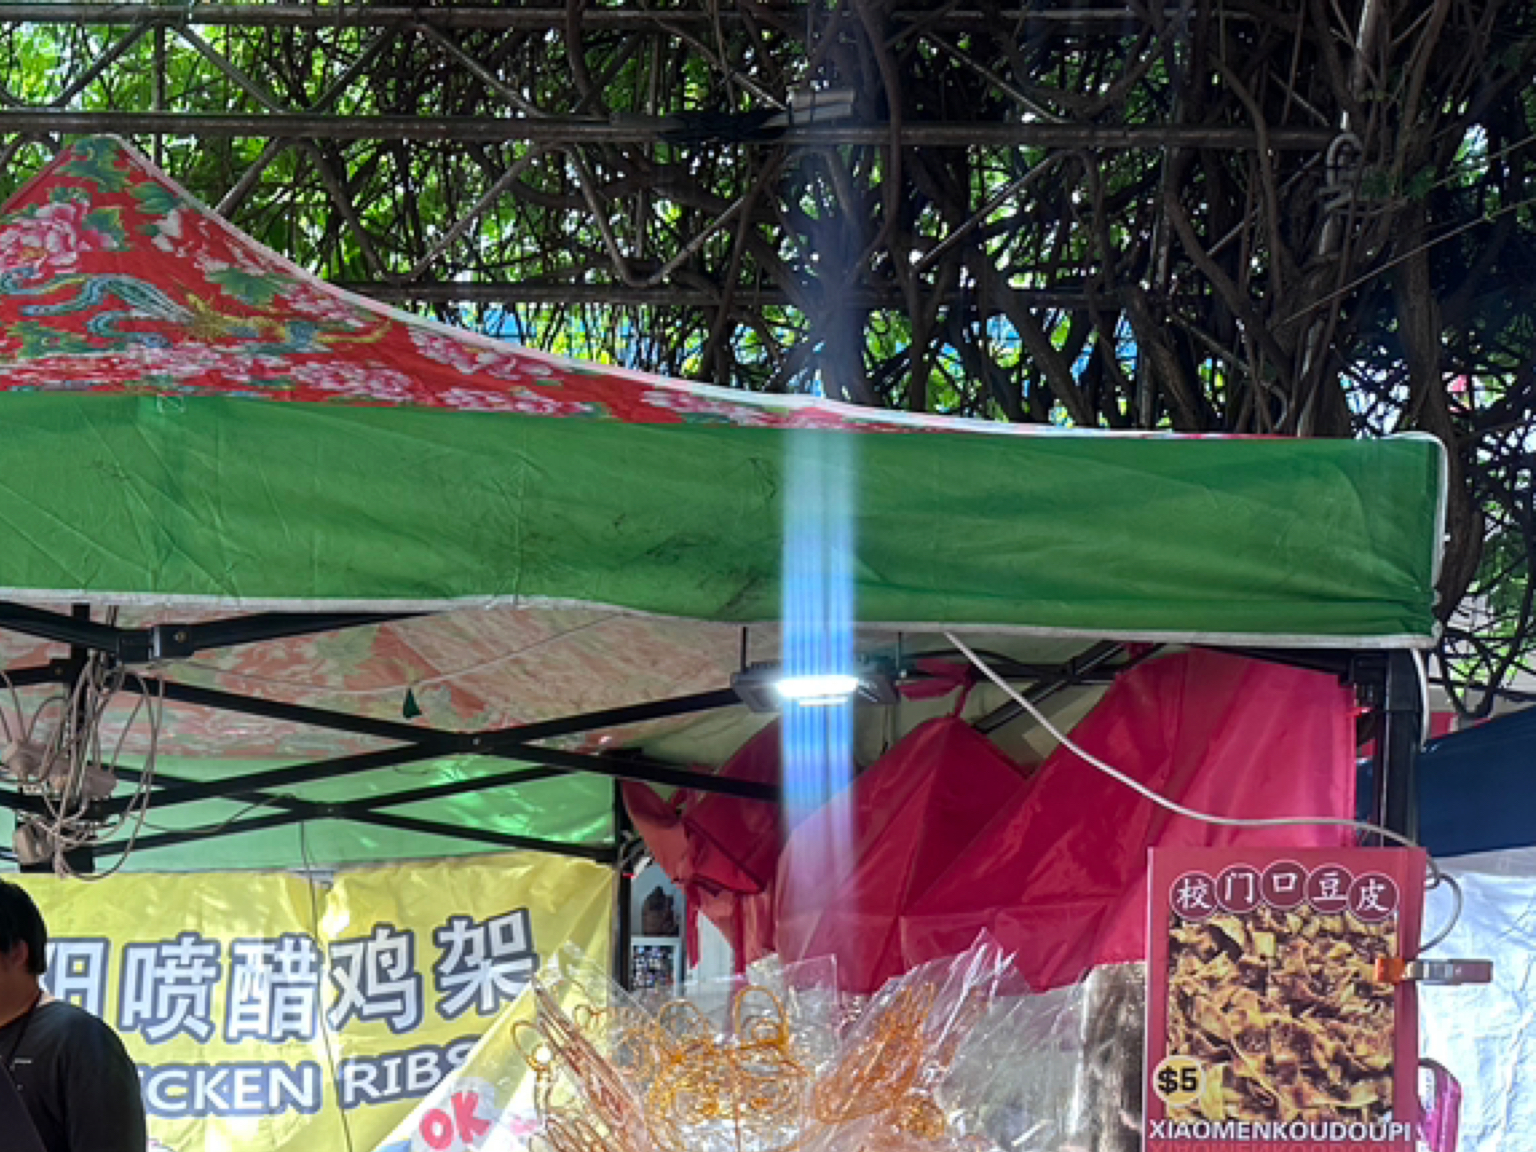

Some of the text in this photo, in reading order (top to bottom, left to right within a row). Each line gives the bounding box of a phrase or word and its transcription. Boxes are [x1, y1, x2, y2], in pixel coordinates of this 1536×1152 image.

[1177, 871, 1389, 913] 校门口豆皮
[1156, 1067, 1198, 1095] $5
[419, 1090, 493, 1152] OK
[1149, 1120, 1411, 1142] XIAOMENKOUDOUPI
